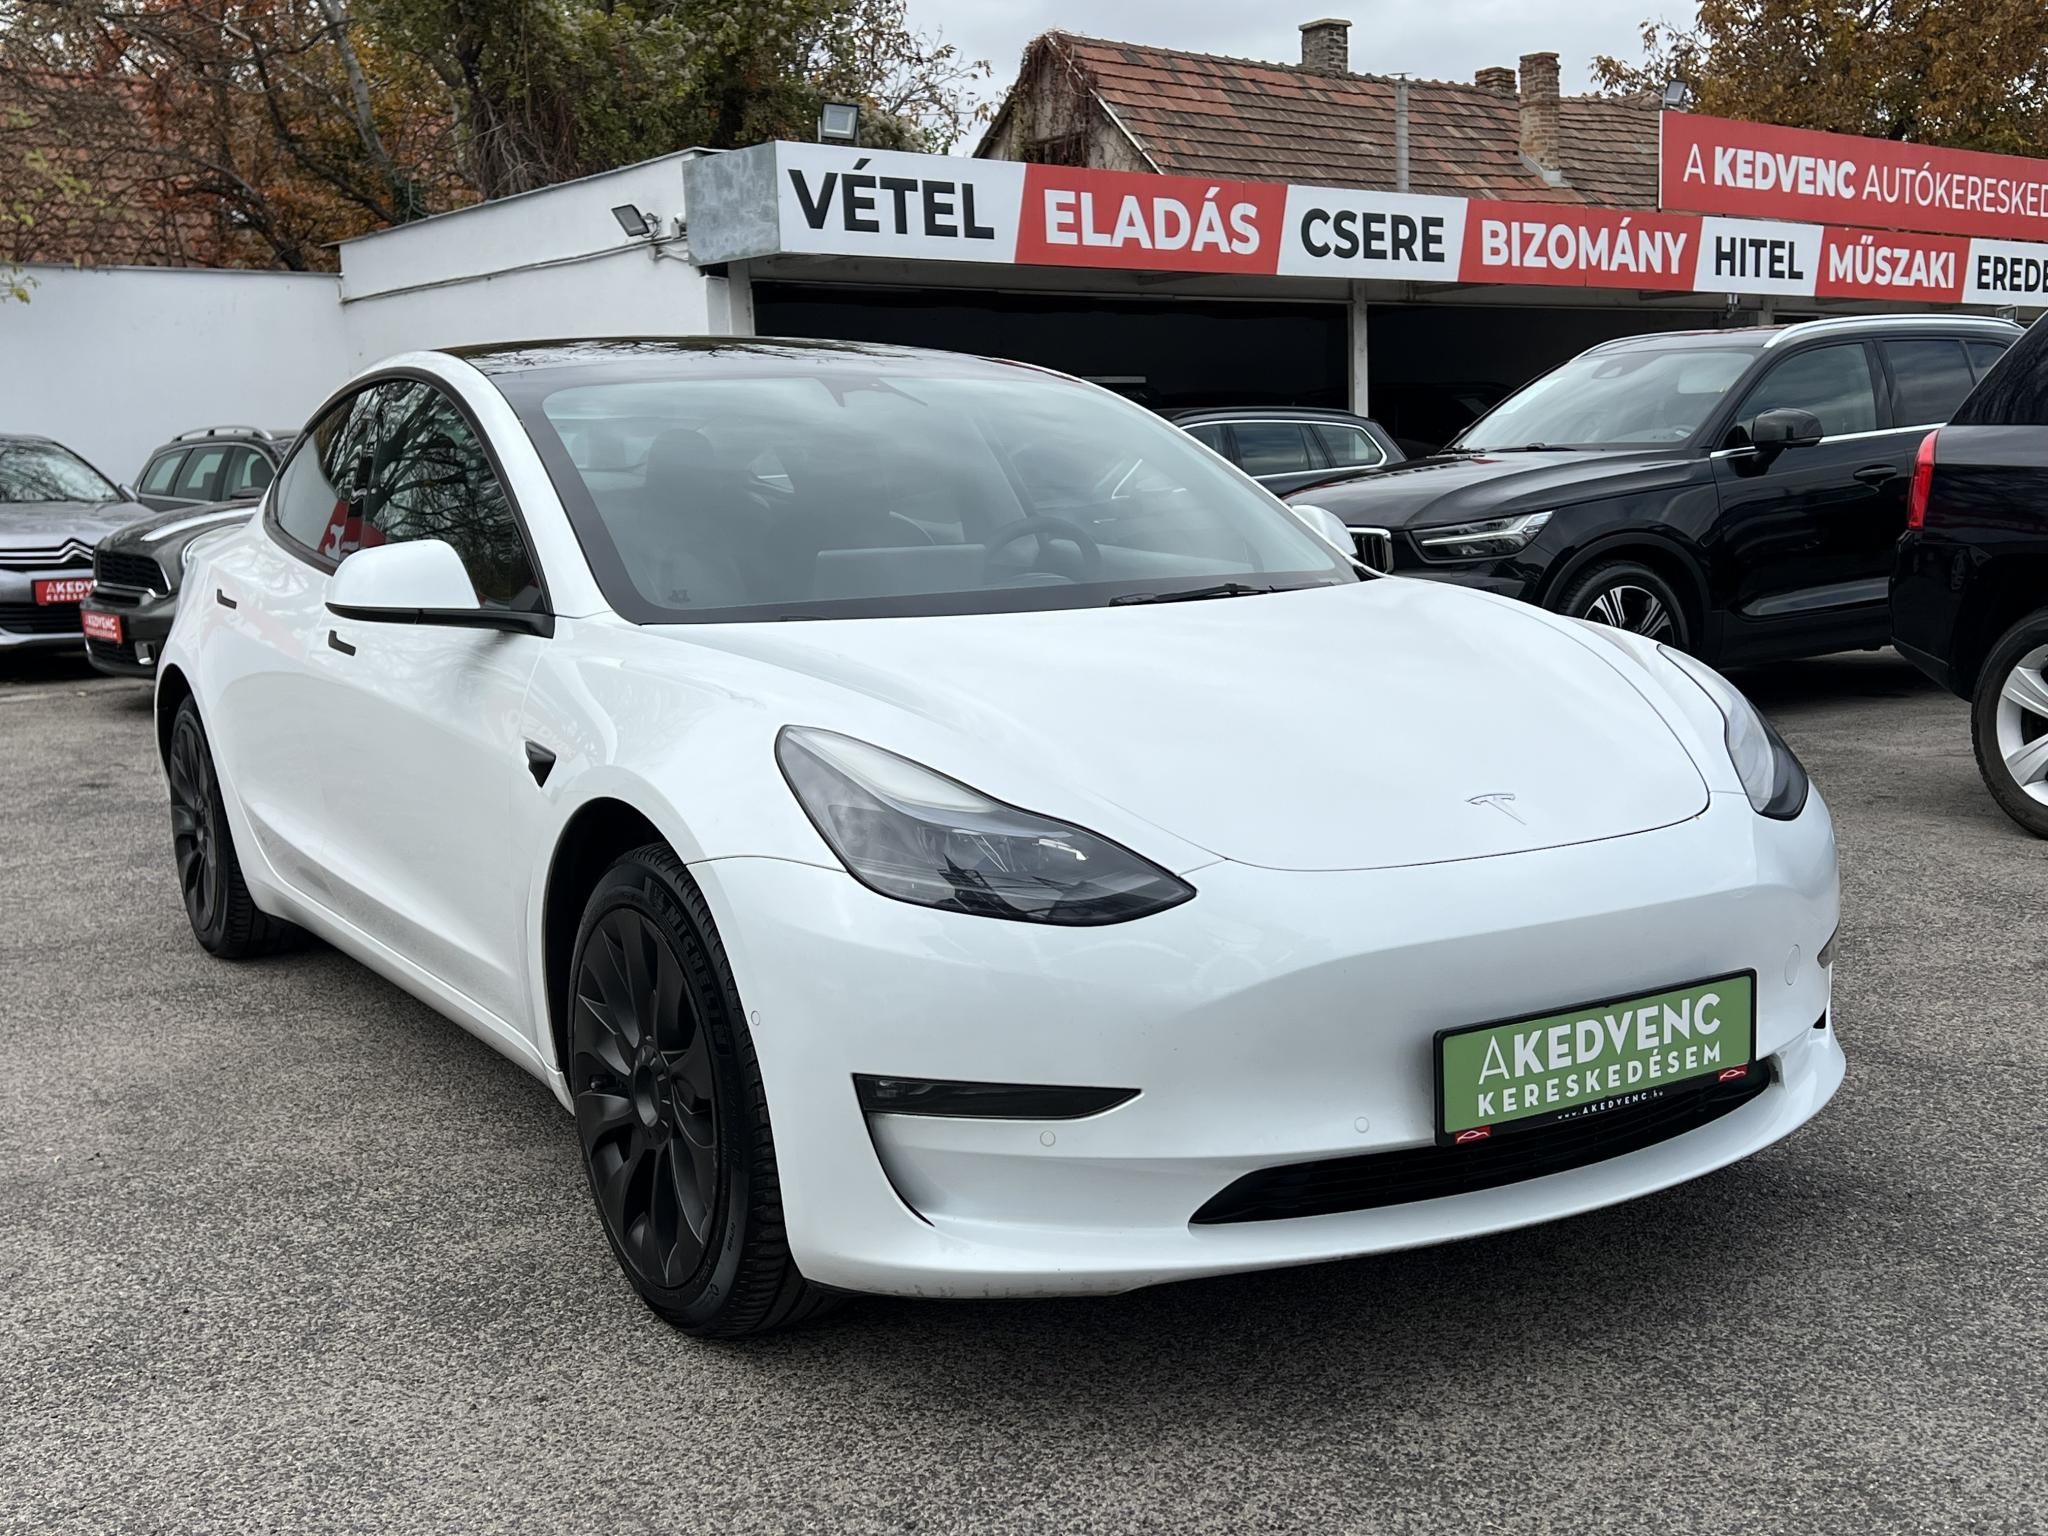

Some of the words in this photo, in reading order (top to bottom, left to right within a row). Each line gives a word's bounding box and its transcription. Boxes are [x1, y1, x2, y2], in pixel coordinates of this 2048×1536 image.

[1683, 143, 1706, 185] A
[1714, 146, 1855, 198] KEDVENC
[788, 158, 994, 239] VÉTEL
[1044, 187, 1260, 254] ELADÁS
[1301, 208, 1445, 262] CSERE
[1481, 217, 1687, 275] BIZOMÁNY
[1715, 236, 1804, 281] HITEL
[1829, 235, 1955, 288] MŰSZAKI
[1477, 1040, 1721, 1118] KERESKEDÉSEM
